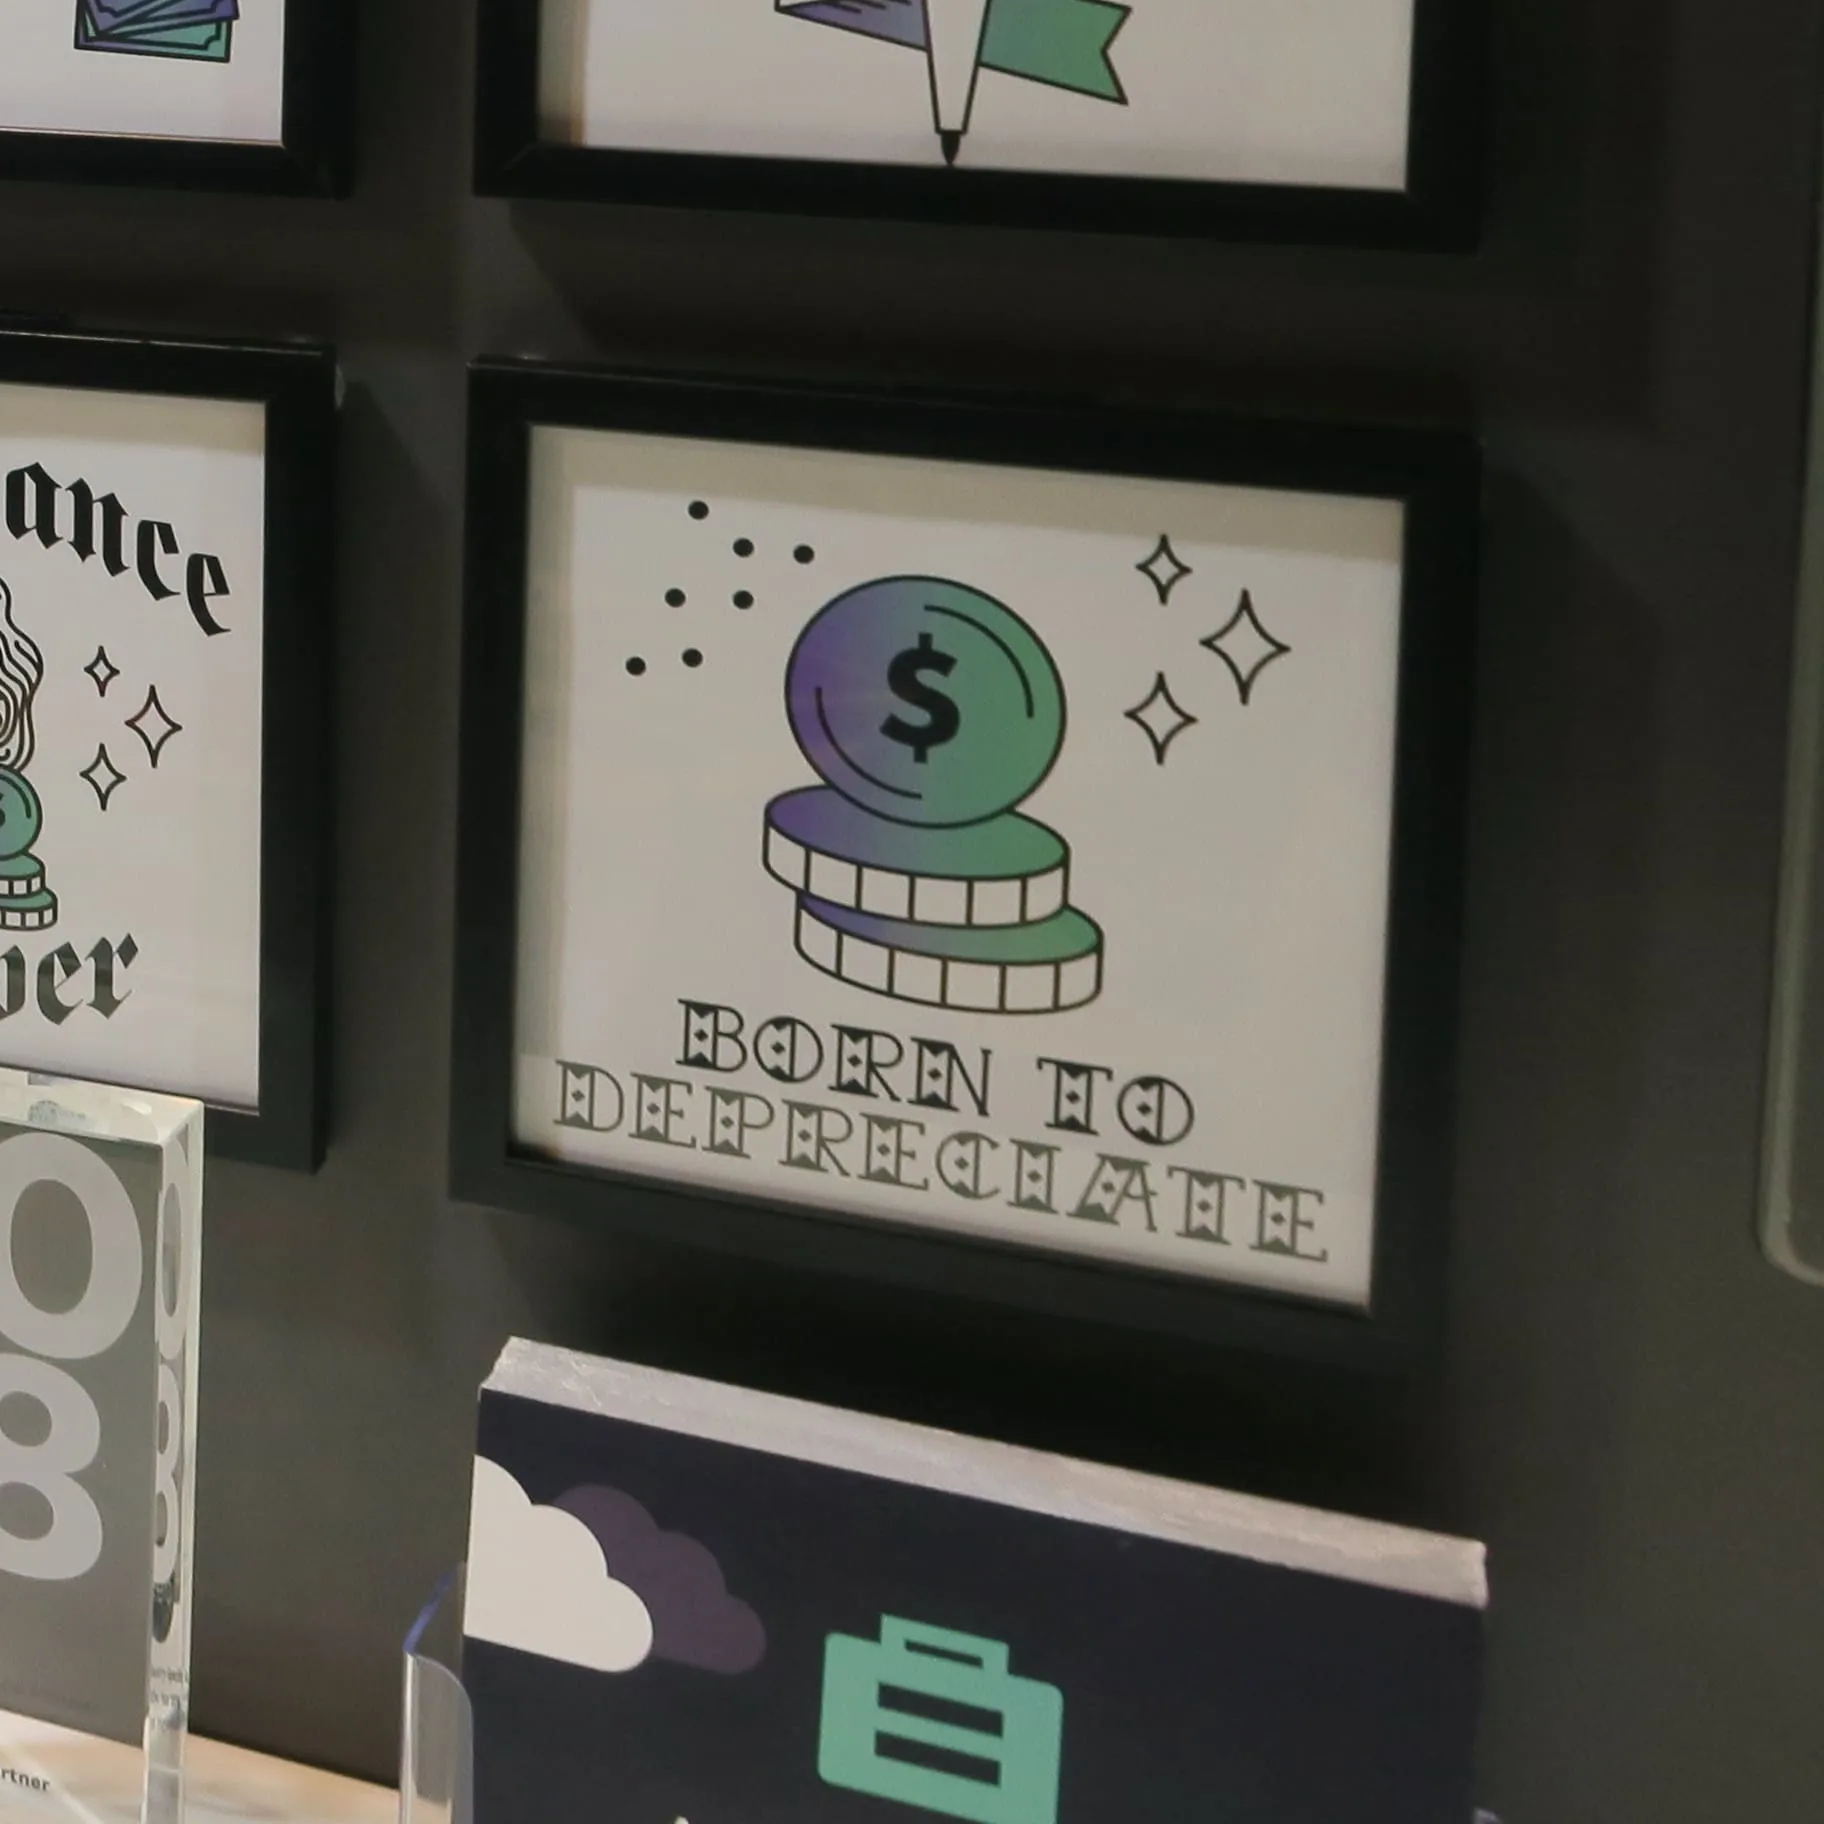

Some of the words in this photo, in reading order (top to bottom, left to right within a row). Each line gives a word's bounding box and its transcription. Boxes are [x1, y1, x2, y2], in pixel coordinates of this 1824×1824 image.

[675, 998, 993, 1116] BORN
[1036, 1056, 1194, 1146] TO
[554, 1058, 1329, 1263] DEPRECIATE
